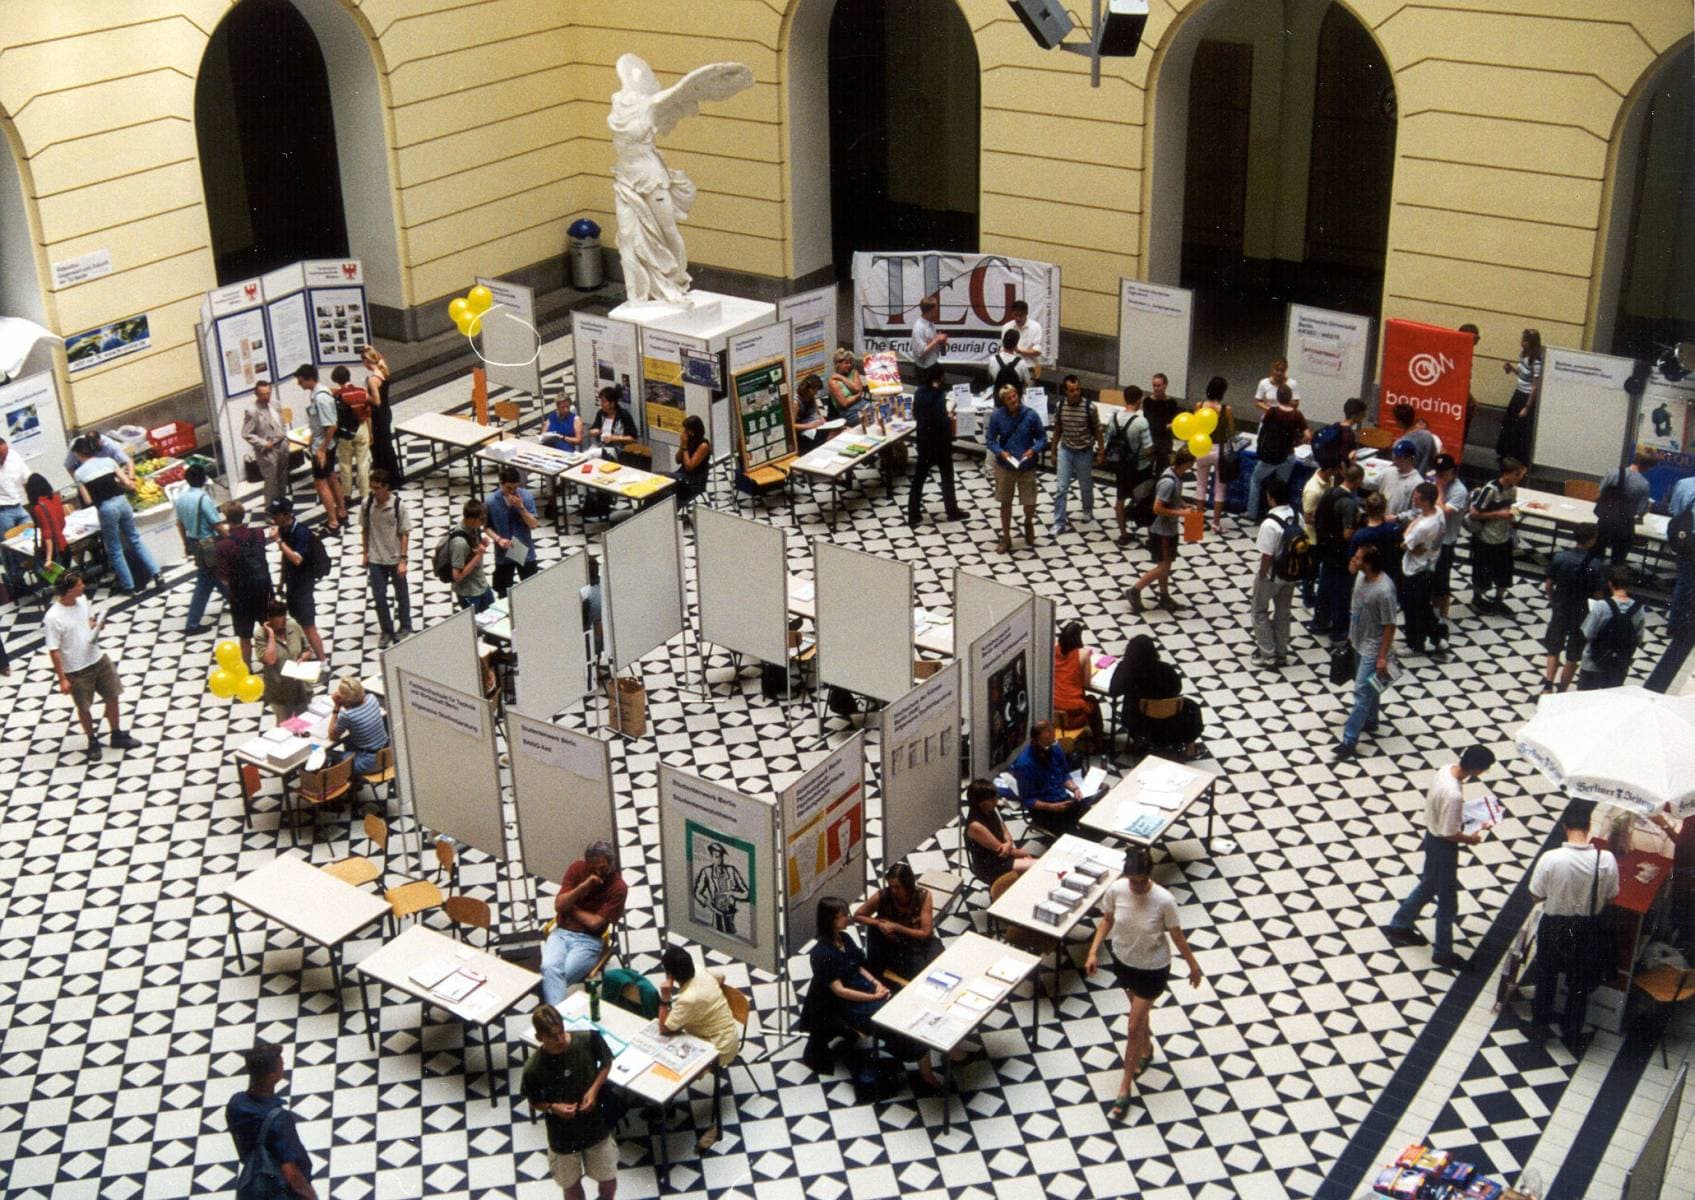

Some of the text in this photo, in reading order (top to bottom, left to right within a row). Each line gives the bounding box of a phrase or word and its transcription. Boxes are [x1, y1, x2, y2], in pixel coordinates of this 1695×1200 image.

[872, 255, 1019, 327] TEG
[864, 338, 886, 352] The
[889, 338, 985, 354] Entneurial
[1385, 390, 1462, 420] bonding
[1576, 782, 1615, 796] Berliner
